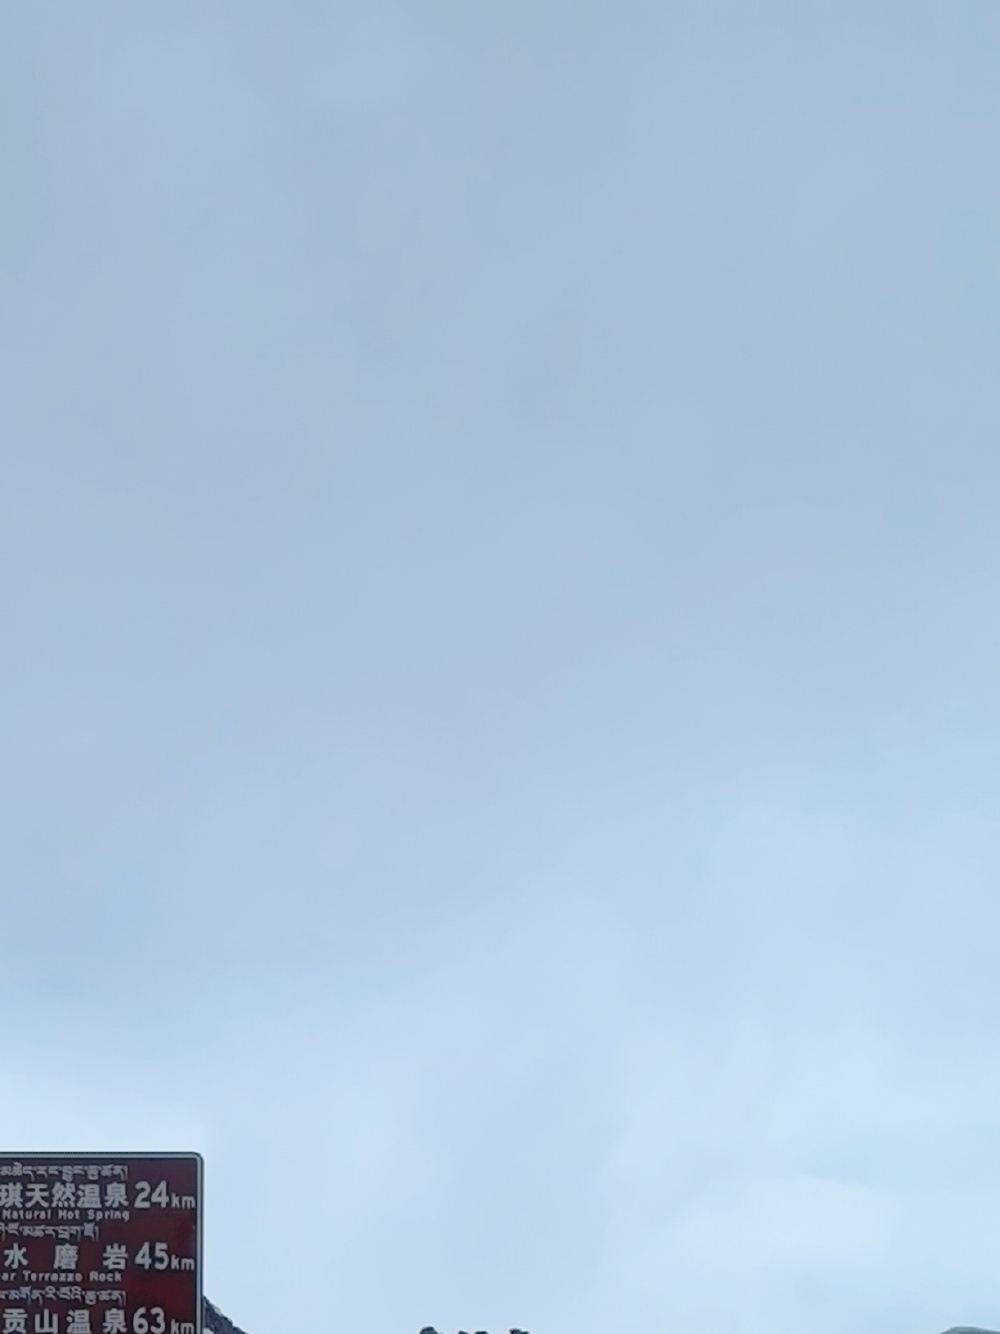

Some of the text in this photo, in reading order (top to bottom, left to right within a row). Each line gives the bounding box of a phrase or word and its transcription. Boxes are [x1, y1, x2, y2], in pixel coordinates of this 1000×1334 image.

[2, 1209, 51, 1220] Natural
[58, 1209, 80, 1220] Hot
[87, 1209, 130, 1222] Spring
[23, 1270, 83, 1282] Terrazzo
[89, 1270, 122, 1282] Rock
